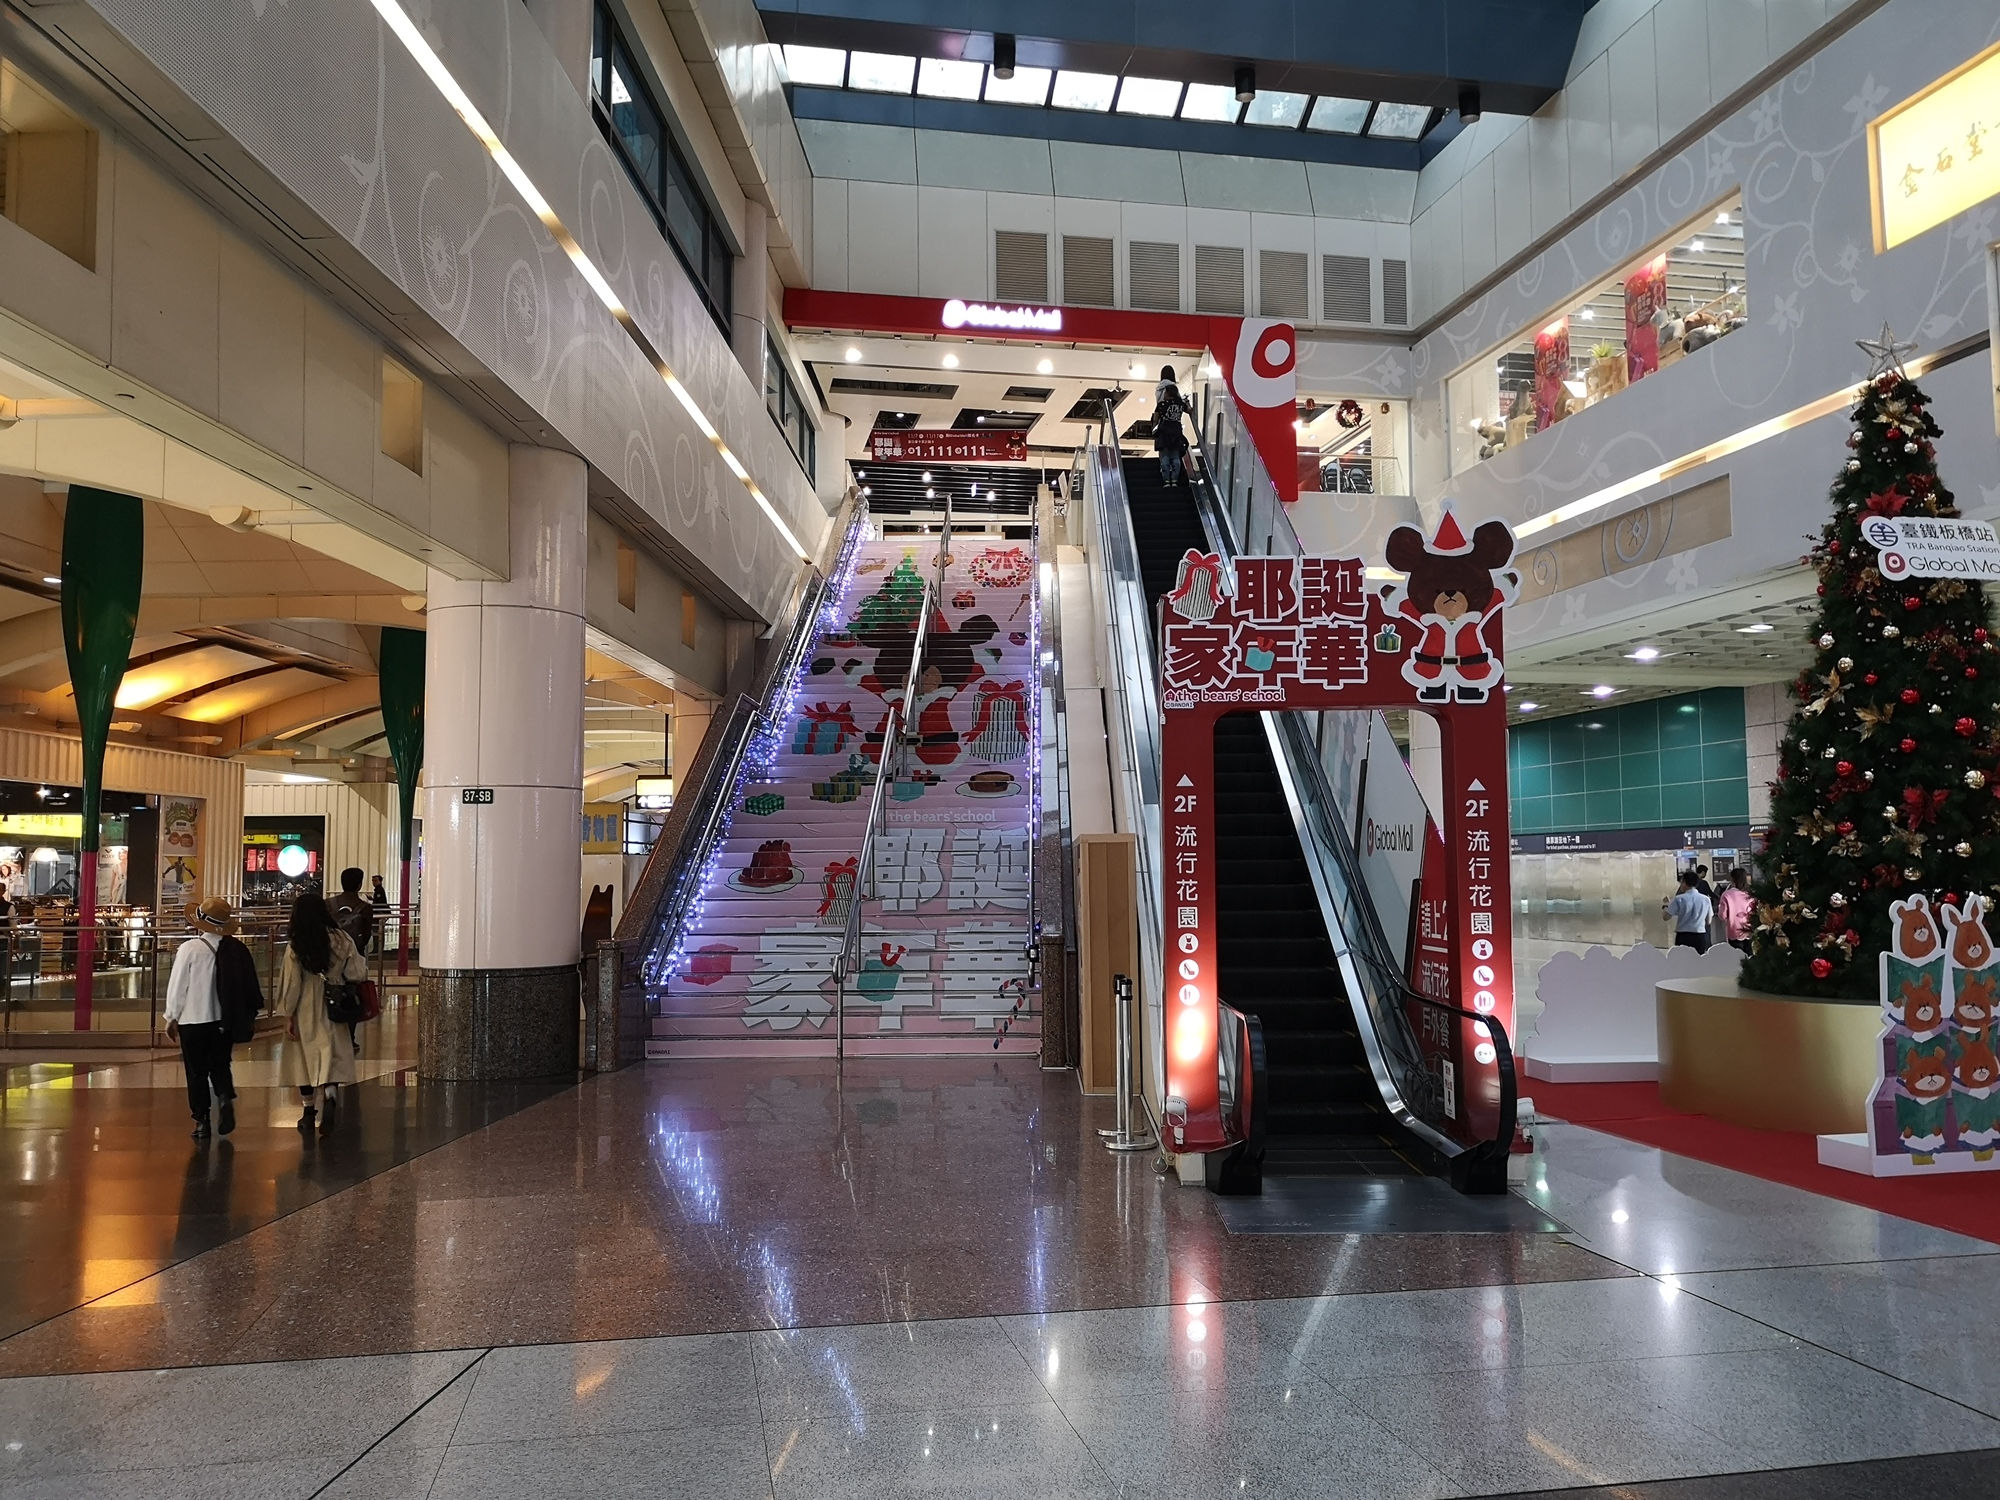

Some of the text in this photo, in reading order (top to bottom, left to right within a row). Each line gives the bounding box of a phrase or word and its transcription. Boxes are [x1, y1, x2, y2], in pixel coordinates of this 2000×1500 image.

[1898, 120, 2000, 199] 金石堂
[1900, 522, 1994, 542] 臺鐵板橋站
[1905, 542, 2000, 554] TRA Banqiao Station
[1908, 556, 2000, 574] Global Ma
[1232, 556, 1369, 622] 耶誕
[1165, 621, 1368, 690] 家年華
[1177, 688, 1286, 702] the bears' school
[464, 790, 491, 801] 37-SB
[889, 810, 911, 822] the
[953, 809, 996, 822] school
[1374, 823, 1414, 852] Global Mall
[862, 827, 1032, 911] 耶誕
[1174, 795, 1199, 929] 2F 流行花園
[1465, 799, 1493, 935] 2F 流行花園
[740, 920, 1032, 1030] 家年華
[1421, 959, 1449, 999] 流行花
[1421, 1006, 1450, 1049] 戶外餐
